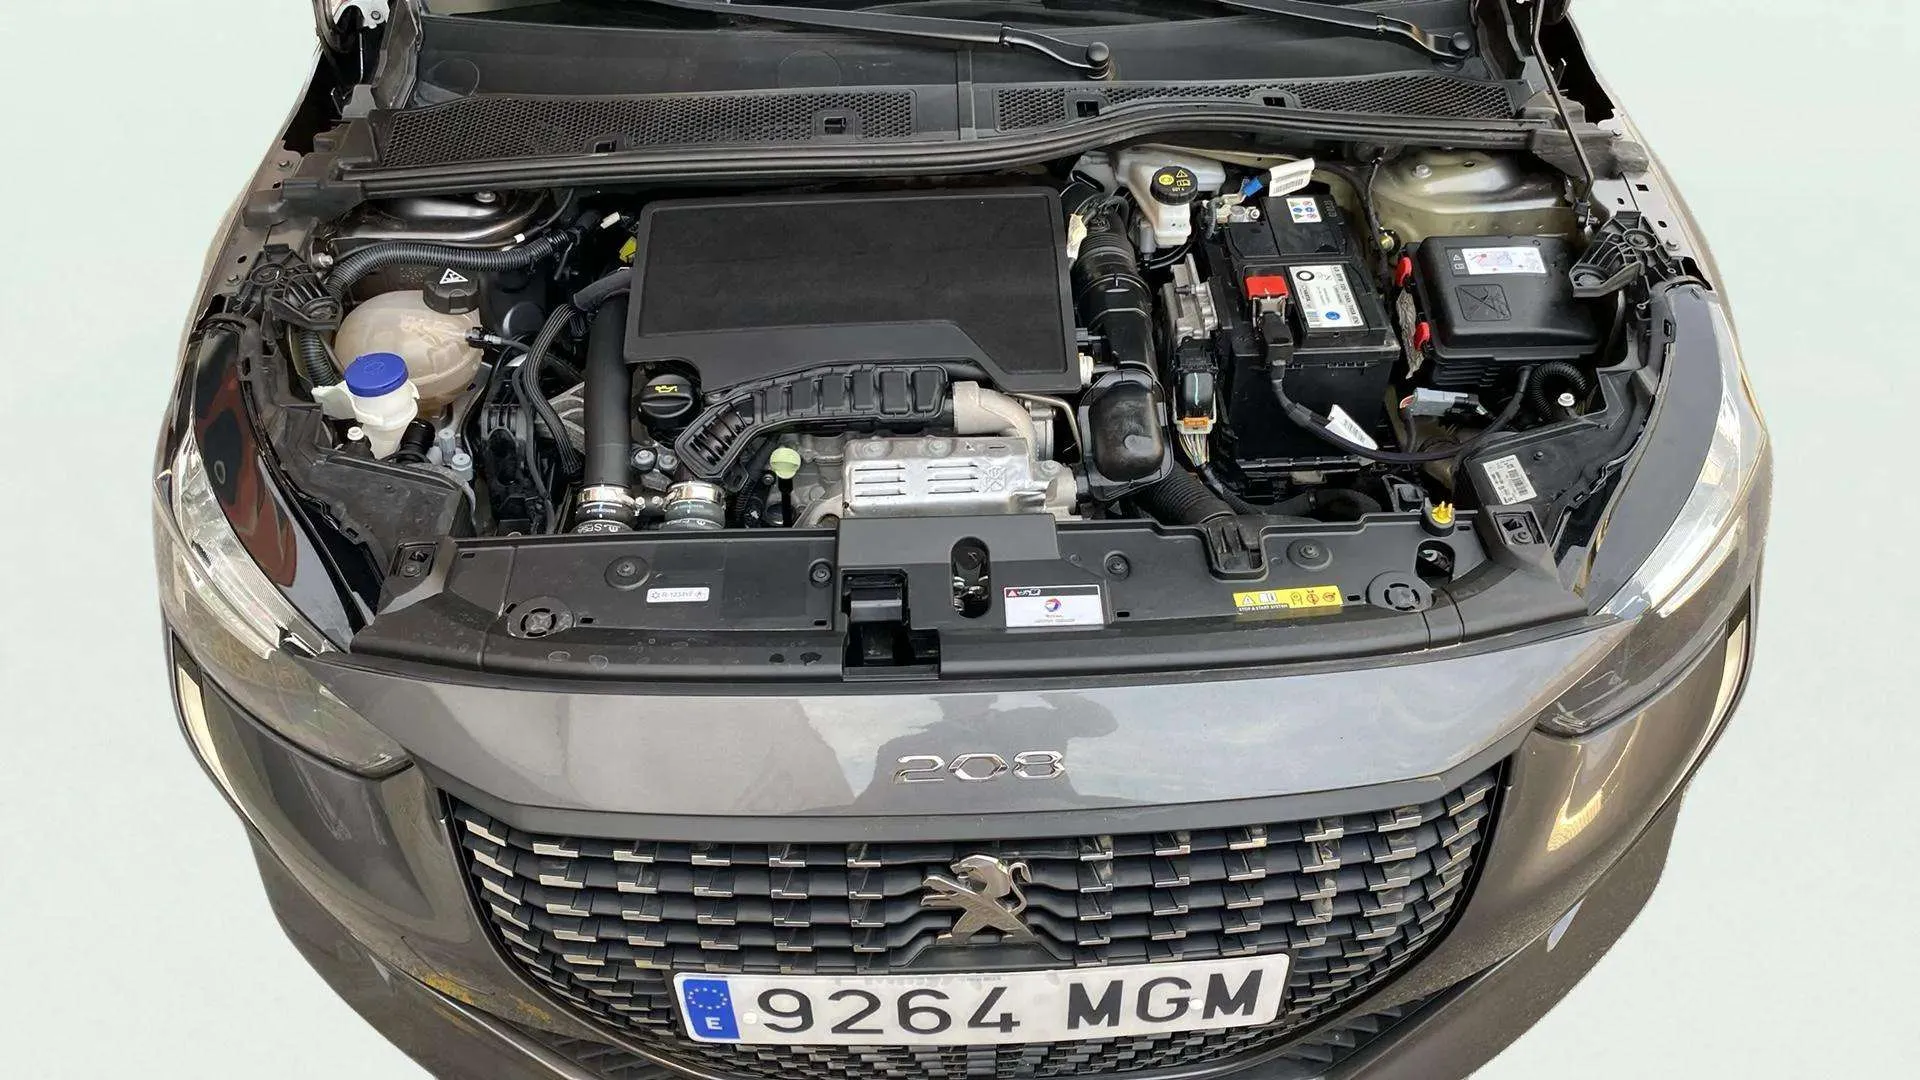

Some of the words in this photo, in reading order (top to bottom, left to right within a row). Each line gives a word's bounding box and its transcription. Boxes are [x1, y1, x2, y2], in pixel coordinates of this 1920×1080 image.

[894, 750, 1066, 783] 208
[705, 1017, 722, 1030] E
[757, 987, 1020, 1034] 9264
[1067, 969, 1263, 1030] MGM
